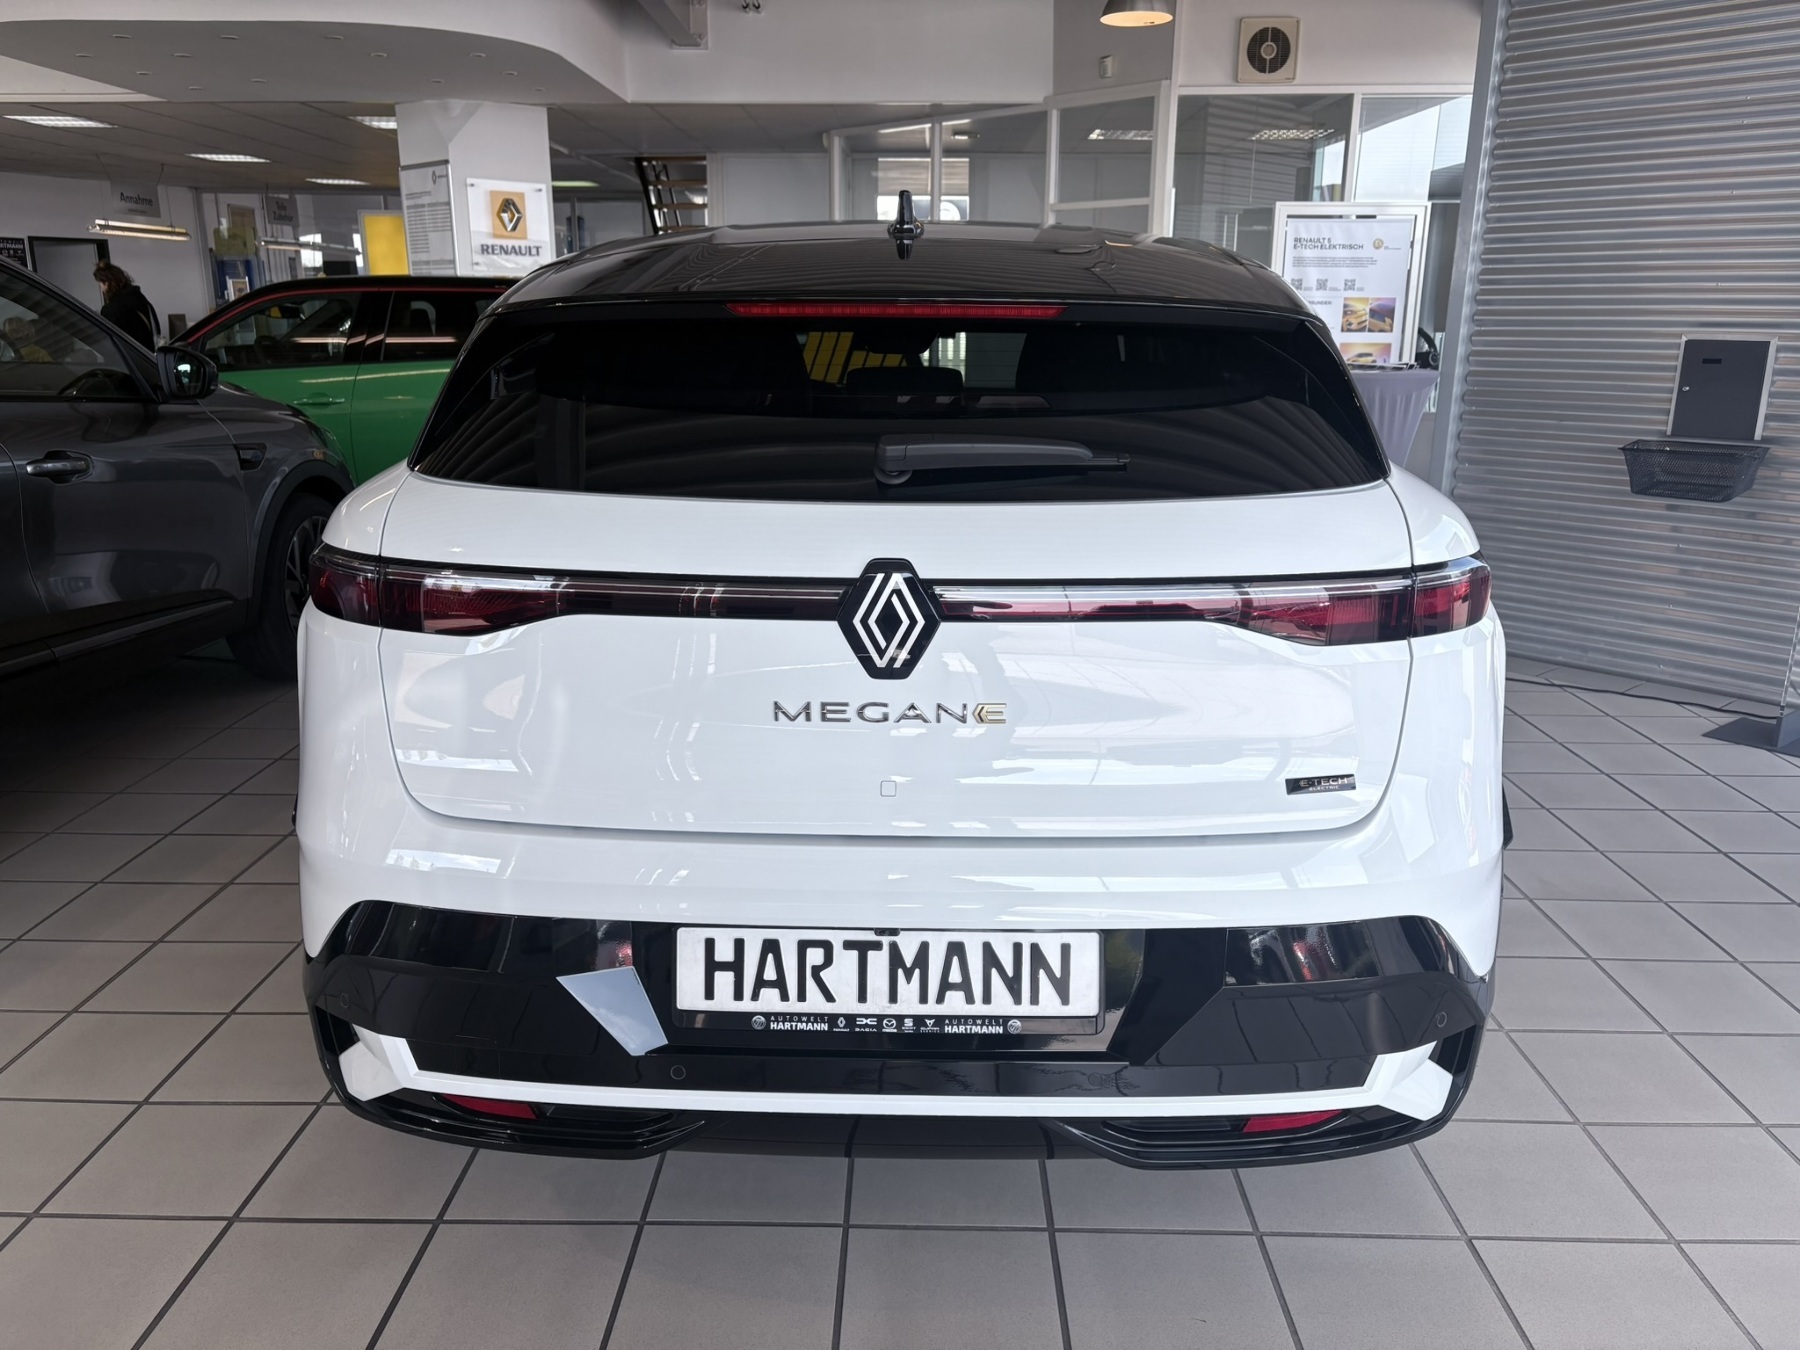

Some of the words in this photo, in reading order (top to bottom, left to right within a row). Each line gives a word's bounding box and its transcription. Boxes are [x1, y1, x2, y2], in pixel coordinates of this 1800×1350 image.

[120, 191, 154, 207] Annahme
[480, 243, 543, 257] RENAULT
[773, 700, 1008, 725] MEGANE
[1300, 777, 1348, 787] E-TECH
[704, 937, 1072, 1007] HARTMANN
[769, 1021, 829, 1031] HARTMANN
[944, 1025, 1004, 1034] HARTMANN
